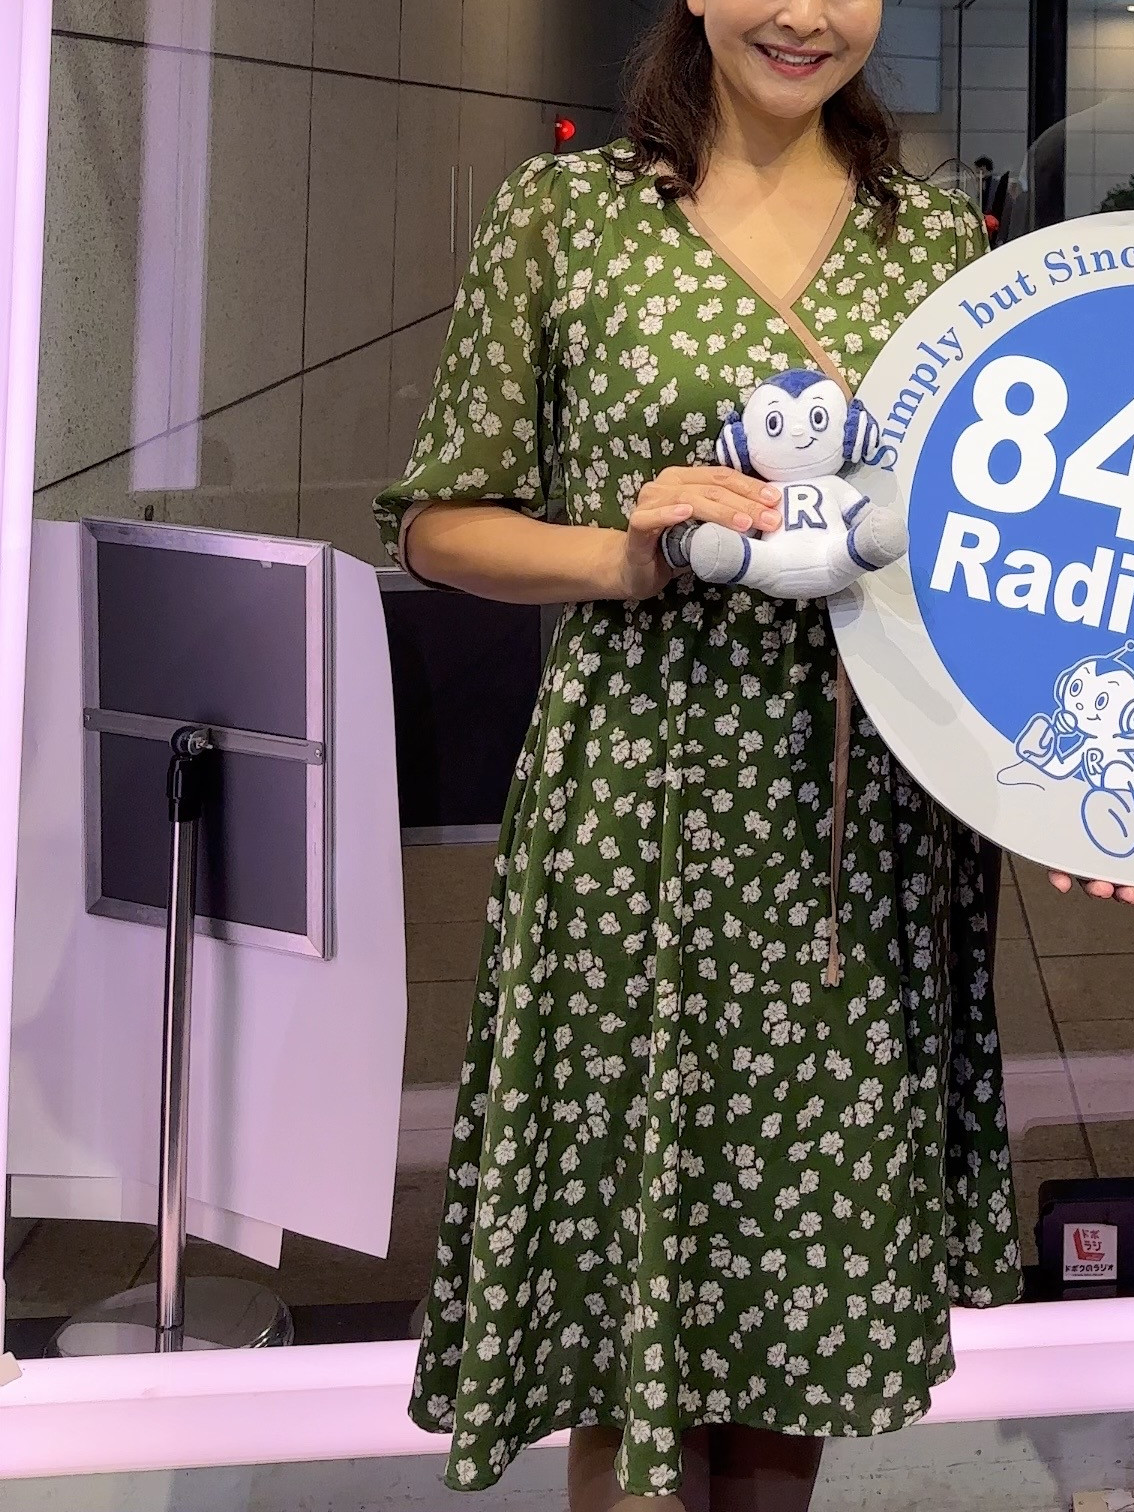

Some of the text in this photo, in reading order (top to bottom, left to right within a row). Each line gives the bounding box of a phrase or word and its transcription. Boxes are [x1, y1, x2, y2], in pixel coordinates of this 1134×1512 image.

[861, 326, 964, 472] Simply
[958, 270, 1037, 329] but
[783, 483, 828, 532] R
[1086, 747, 1105, 776] R
